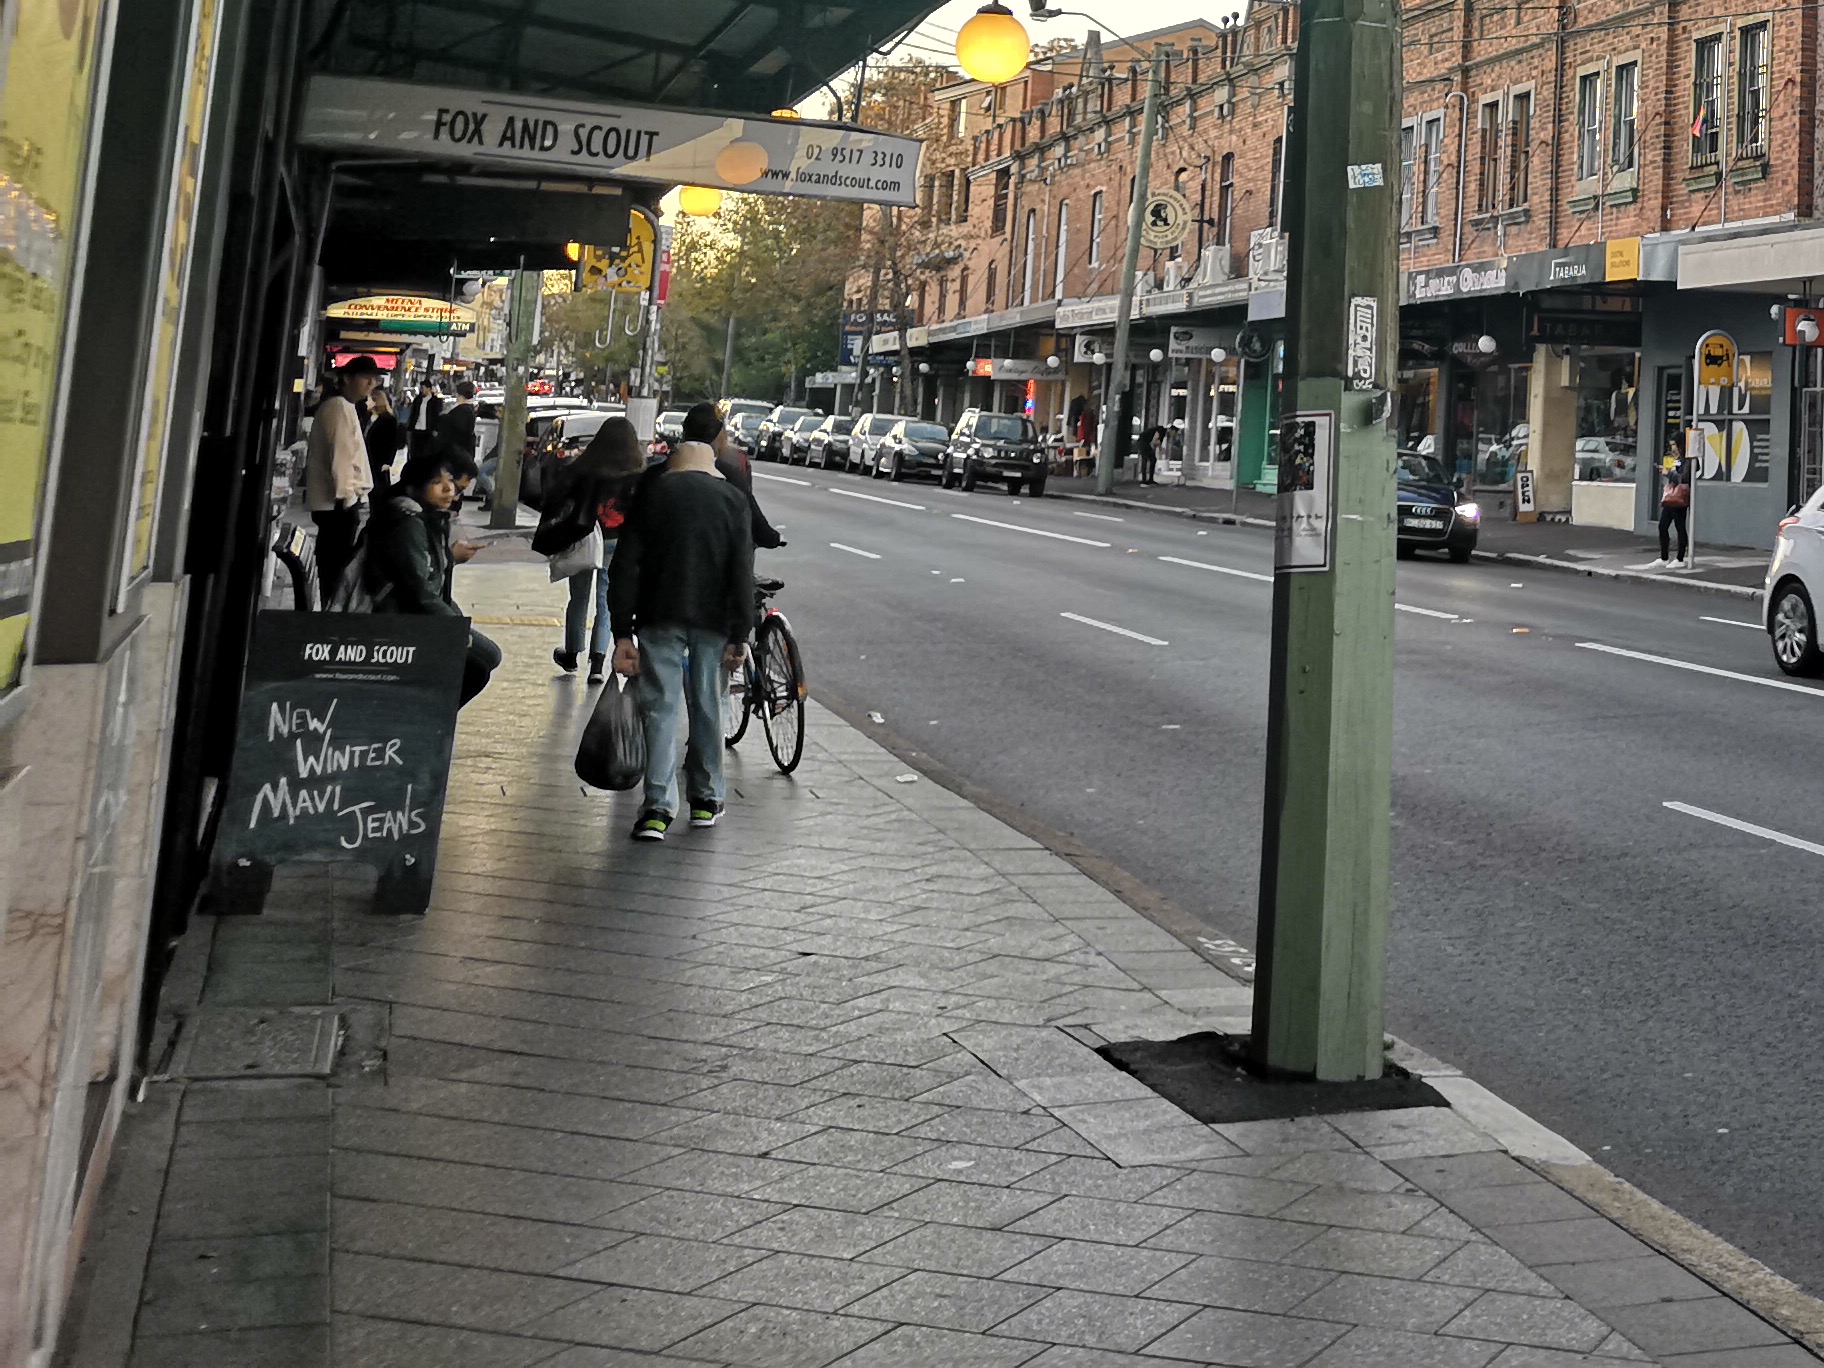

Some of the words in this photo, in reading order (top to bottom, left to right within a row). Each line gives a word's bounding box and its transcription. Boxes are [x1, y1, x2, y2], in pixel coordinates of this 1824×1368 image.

[433, 107, 488, 147] FOX
[498, 114, 559, 153] AND
[571, 123, 660, 163] SCOUT
[805, 143, 825, 161] 02
[830, 145, 864, 165] 9517
[870, 150, 904, 169] 3310
[760, 165, 902, 193] www.foxandscout.com
[450, 321, 470, 331] ATM
[304, 642, 333, 661] FOX
[335, 644, 367, 663] AND
[371, 645, 417, 664] SCOUT
[268, 698, 338, 742] NEW
[296, 729, 403, 779] WINTER
[249, 777, 342, 829] MAVI
[338, 783, 426, 849] JEANS
